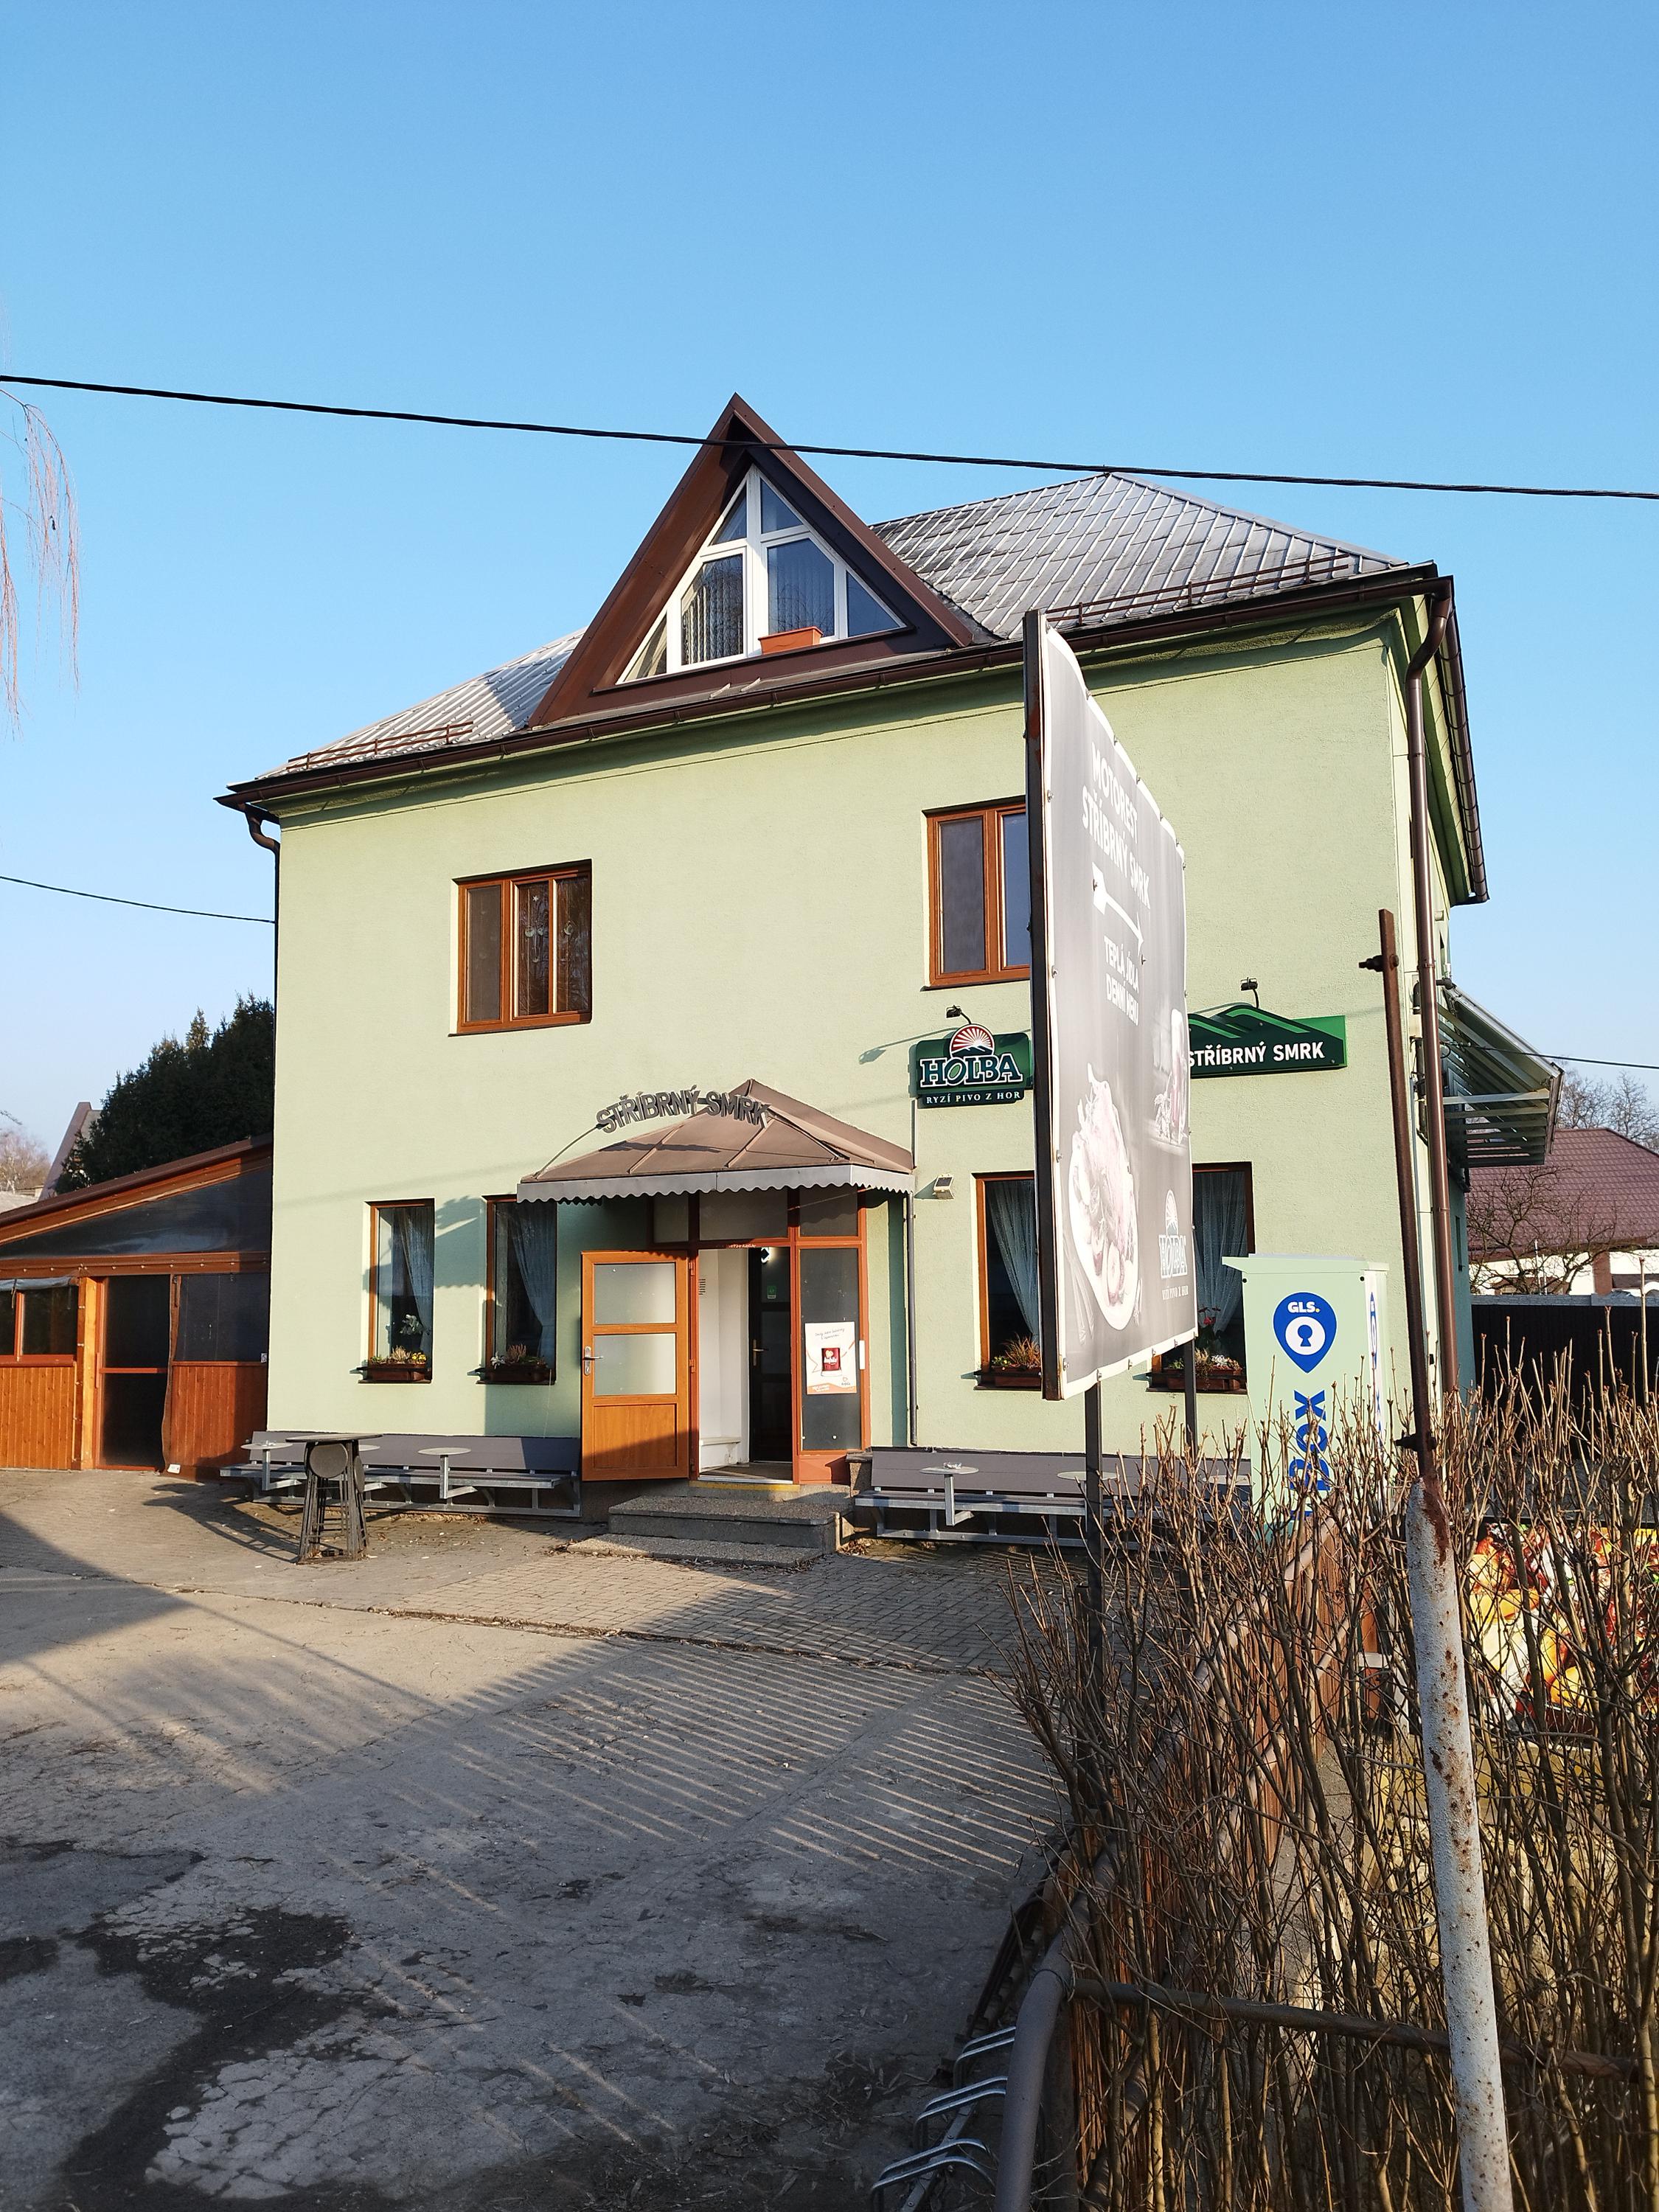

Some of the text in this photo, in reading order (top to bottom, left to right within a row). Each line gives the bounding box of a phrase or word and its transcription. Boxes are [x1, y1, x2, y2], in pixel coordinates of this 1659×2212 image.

[1092, 742, 1138, 844] MOTOREST
[1082, 785, 1151, 910] STŘÍBRNÝ SMRK
[1104, 935, 1126, 978] TEPLÁ
[1126, 990, 1139, 1026] MENU
[919, 1053, 1023, 1088] HOLBA
[1189, 1040, 1325, 1067] STŘÍBRNÝ SMRK
[596, 1085, 770, 1133] STŘÍBRNÝ SMRK
[926, 1091, 1021, 1105] RYZÍ PIVO Z HOR
[1158, 1234, 1189, 1279] HOLBA
